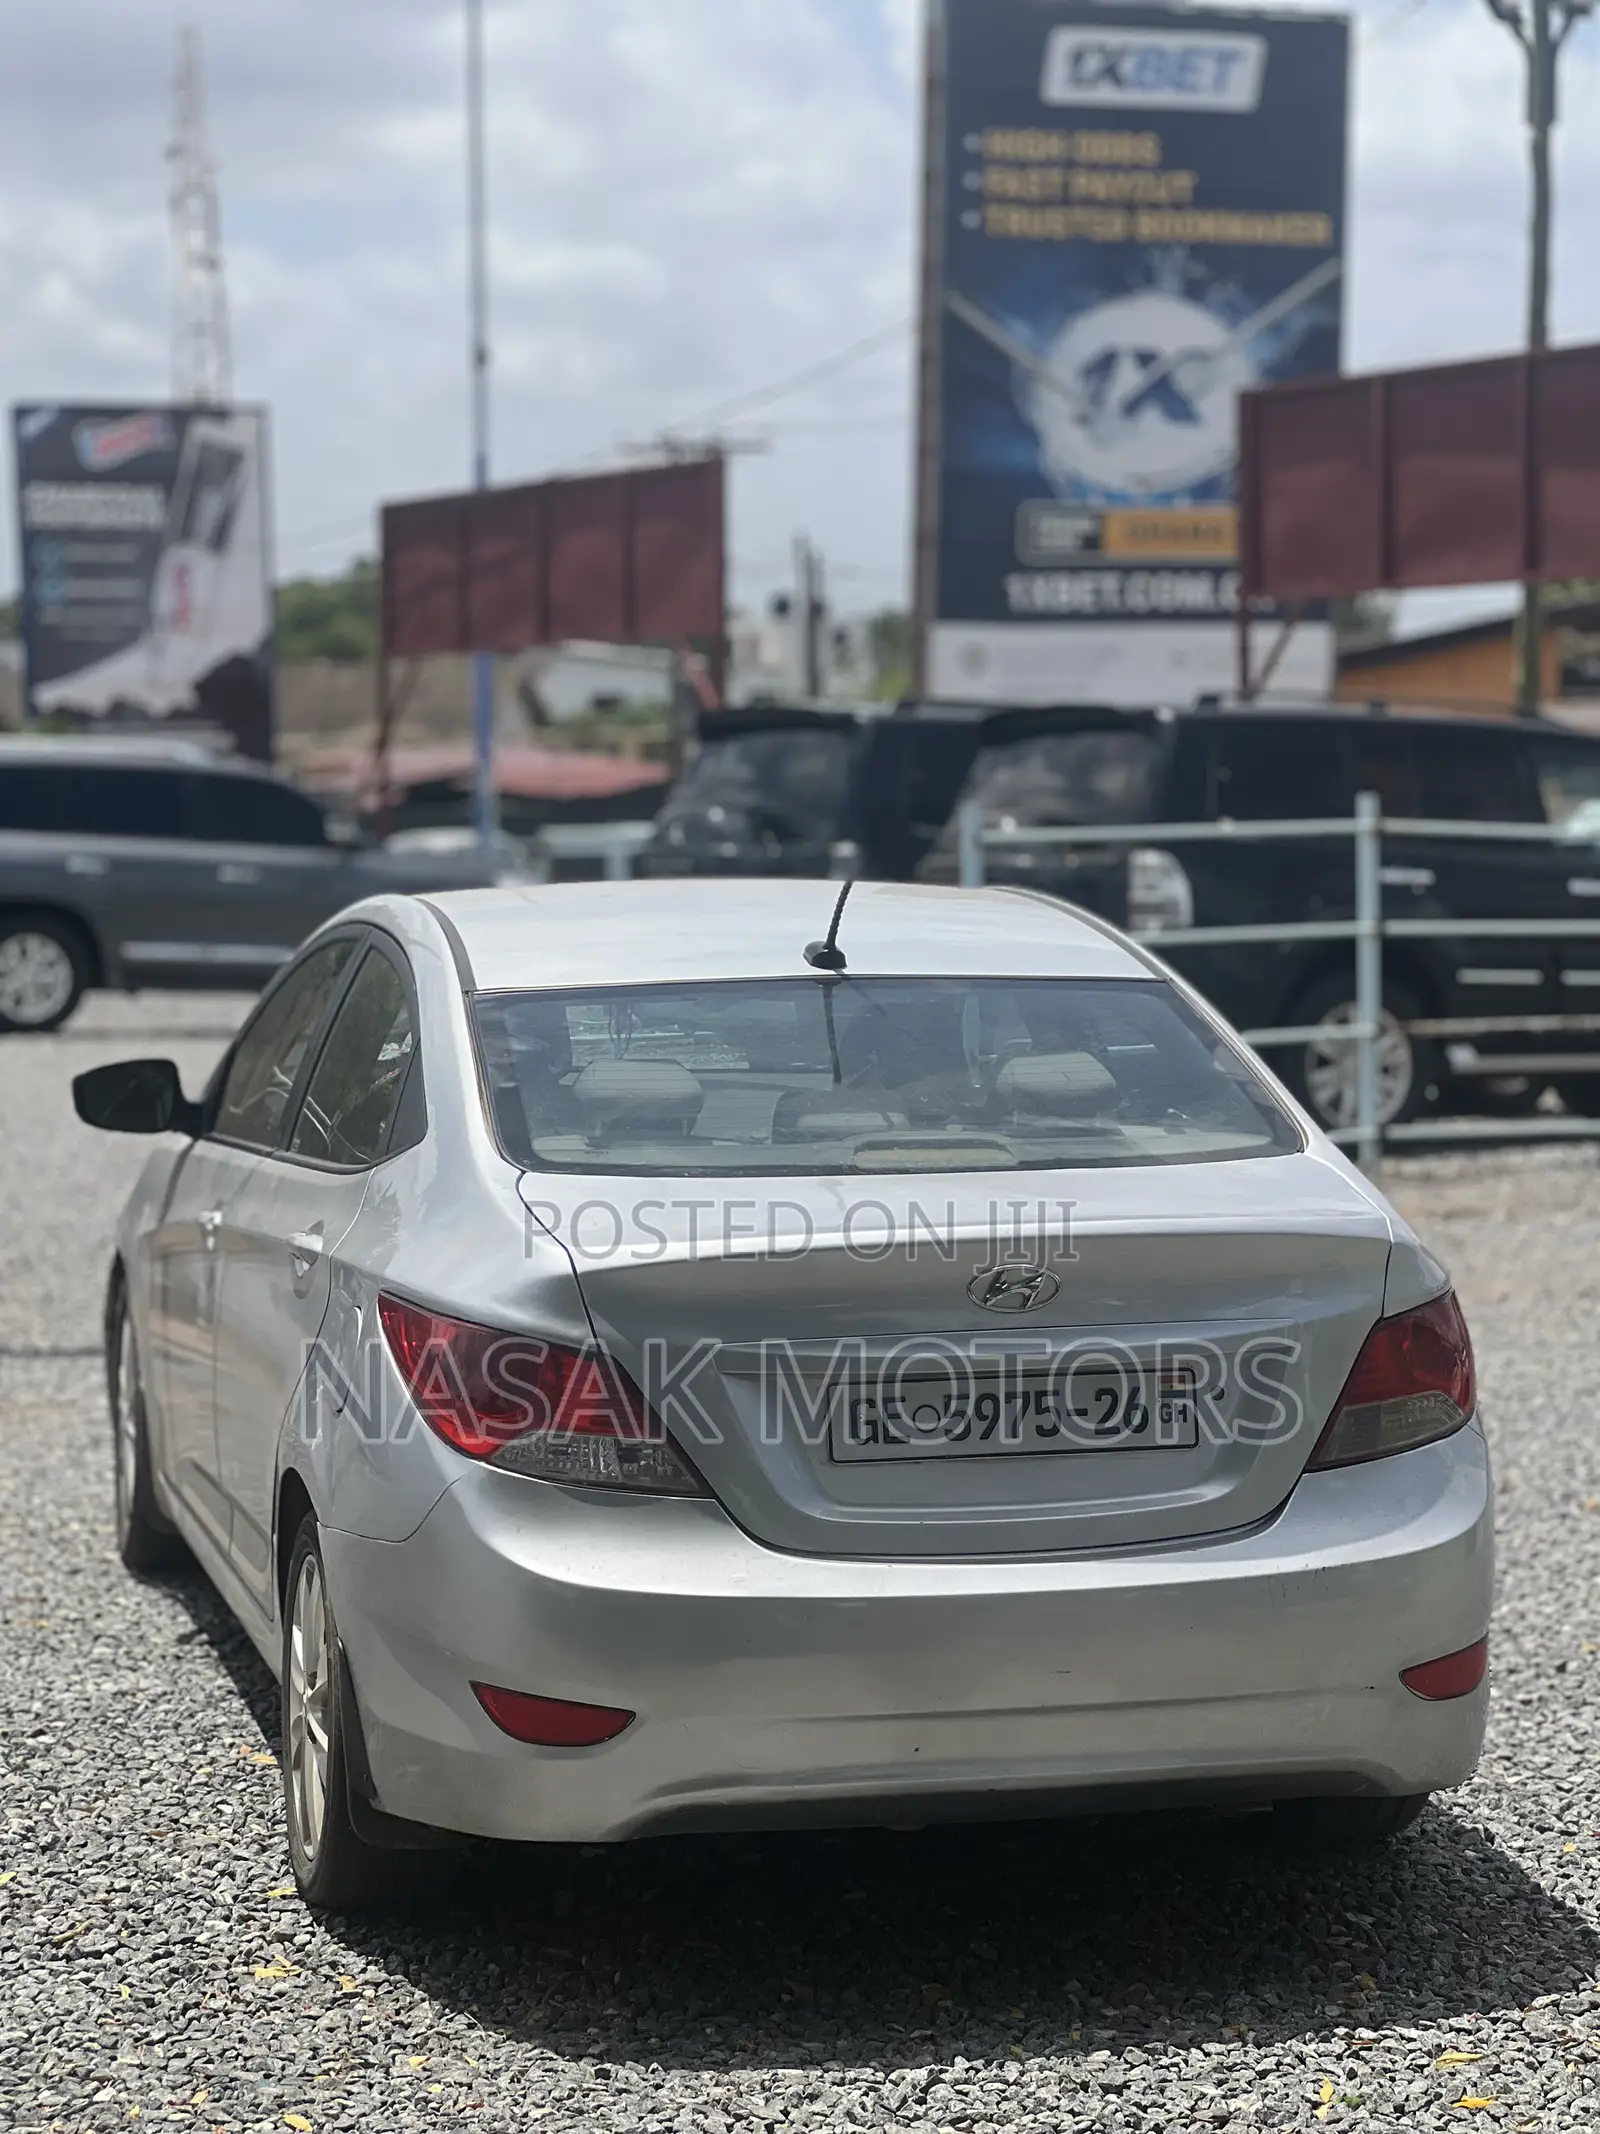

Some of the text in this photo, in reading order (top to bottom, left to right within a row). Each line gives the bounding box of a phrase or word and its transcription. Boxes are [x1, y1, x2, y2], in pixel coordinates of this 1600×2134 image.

[1066, 38, 1249, 95] 1XBET
[850, 1385, 1150, 1446] GE 5975-26
[1159, 1402, 1189, 1424] GH
